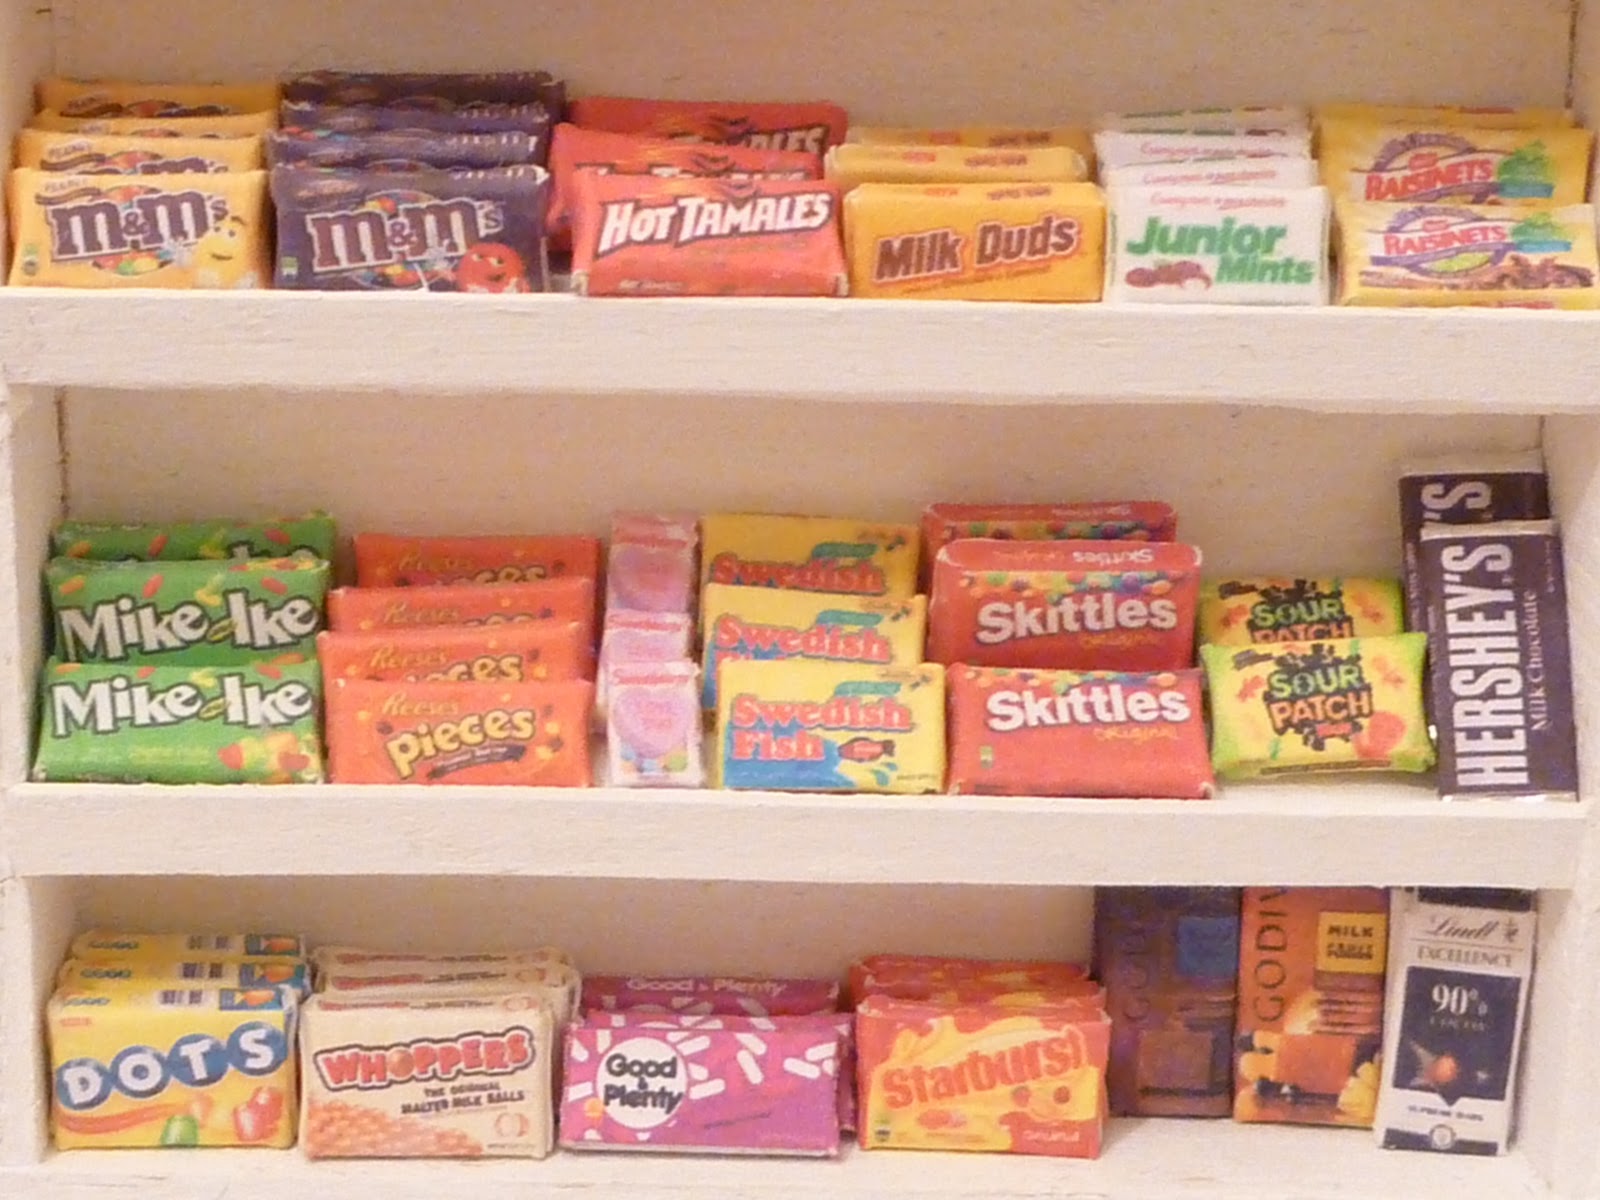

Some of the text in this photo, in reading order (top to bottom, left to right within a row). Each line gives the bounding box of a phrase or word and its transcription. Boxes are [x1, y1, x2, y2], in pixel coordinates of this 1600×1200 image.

[874, 214, 1079, 283] Milk Duds
[1126, 216, 1287, 255] Junior
[1214, 254, 1314, 284] Mints
[57, 596, 210, 661] Mike
[227, 590, 319, 647] Ike
[976, 593, 1178, 643] Skittles
[1253, 599, 1342, 627] SOUR
[715, 615, 891, 663] Swedish
[1521, 590, 1553, 731] Milk Chocolate
[1270, 664, 1361, 698] SOUR
[1441, 543, 1529, 787] HERSHEY'S
[52, 674, 314, 738] Mike Ike
[732, 693, 914, 731] Swedish
[985, 684, 1192, 732] Skittles
[1270, 690, 1372, 730] PATCH
[386, 709, 535, 780] pieces
[732, 730, 825, 760] Fish
[63, 1028, 275, 1106] DOTS
[321, 1032, 529, 1086] WHOPPERS
[605, 1053, 678, 1080] Good
[883, 1030, 1082, 1110] Starburst
[603, 1082, 684, 1115] Plenty
